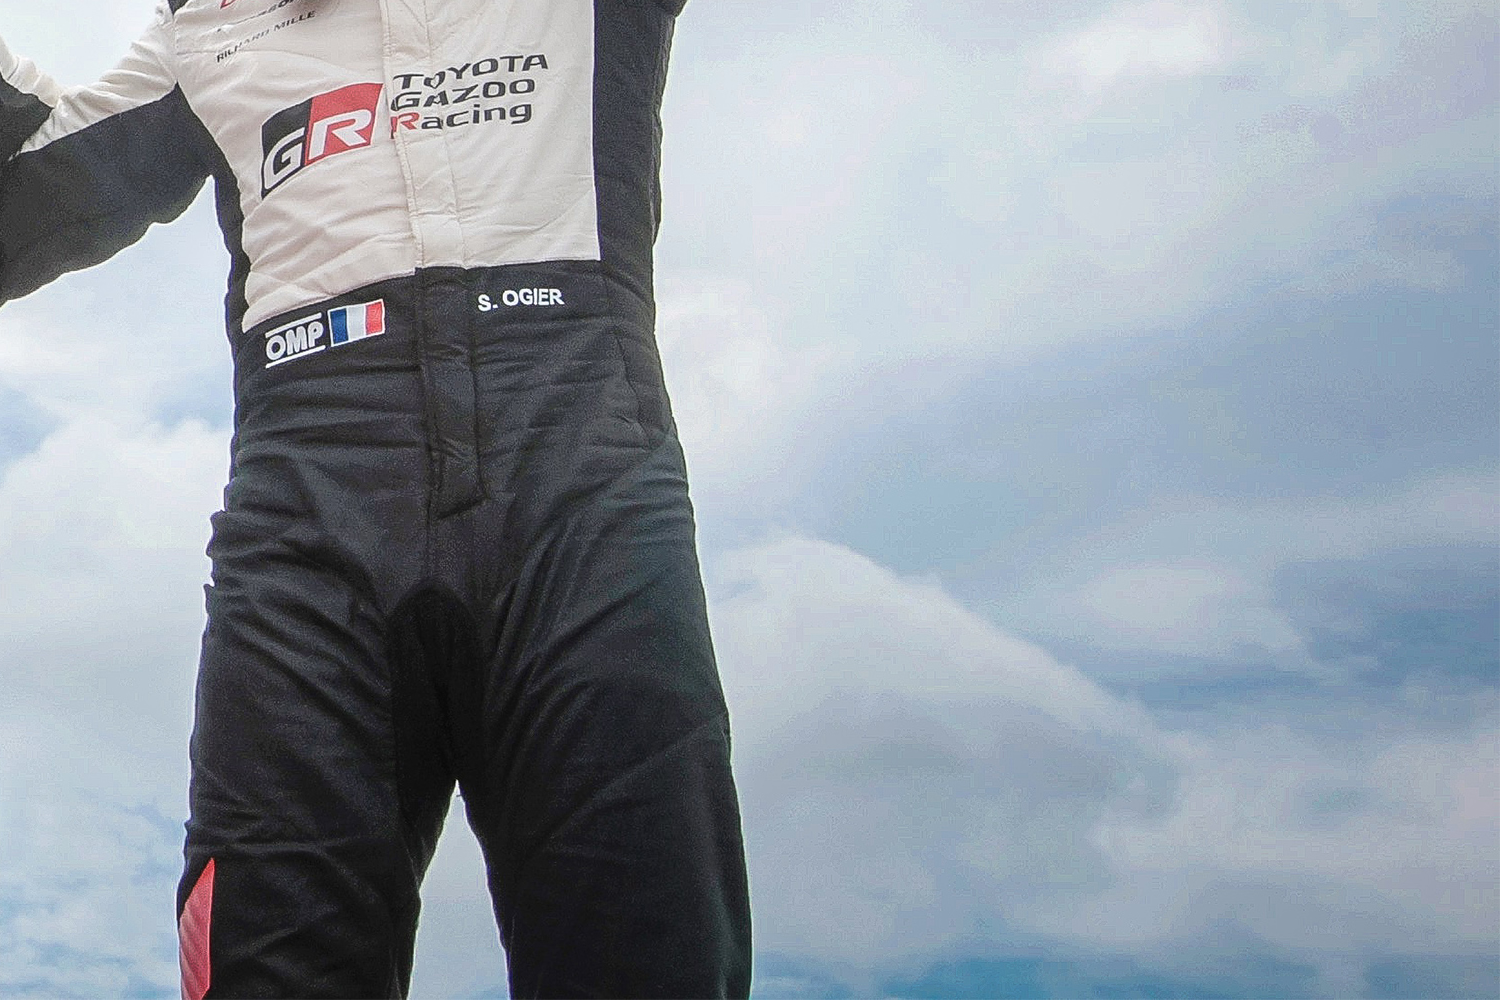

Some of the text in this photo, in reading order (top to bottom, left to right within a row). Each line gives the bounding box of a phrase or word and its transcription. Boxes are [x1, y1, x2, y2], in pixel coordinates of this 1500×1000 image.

[273, 10, 316, 31] MILLE
[392, 54, 549, 91] TOYOTA
[390, 78, 536, 112] GAZOO
[390, 103, 533, 139] Racing
[264, 109, 372, 189] GR
[477, 288, 565, 312] S. OGIER
[264, 320, 324, 361] OMP
